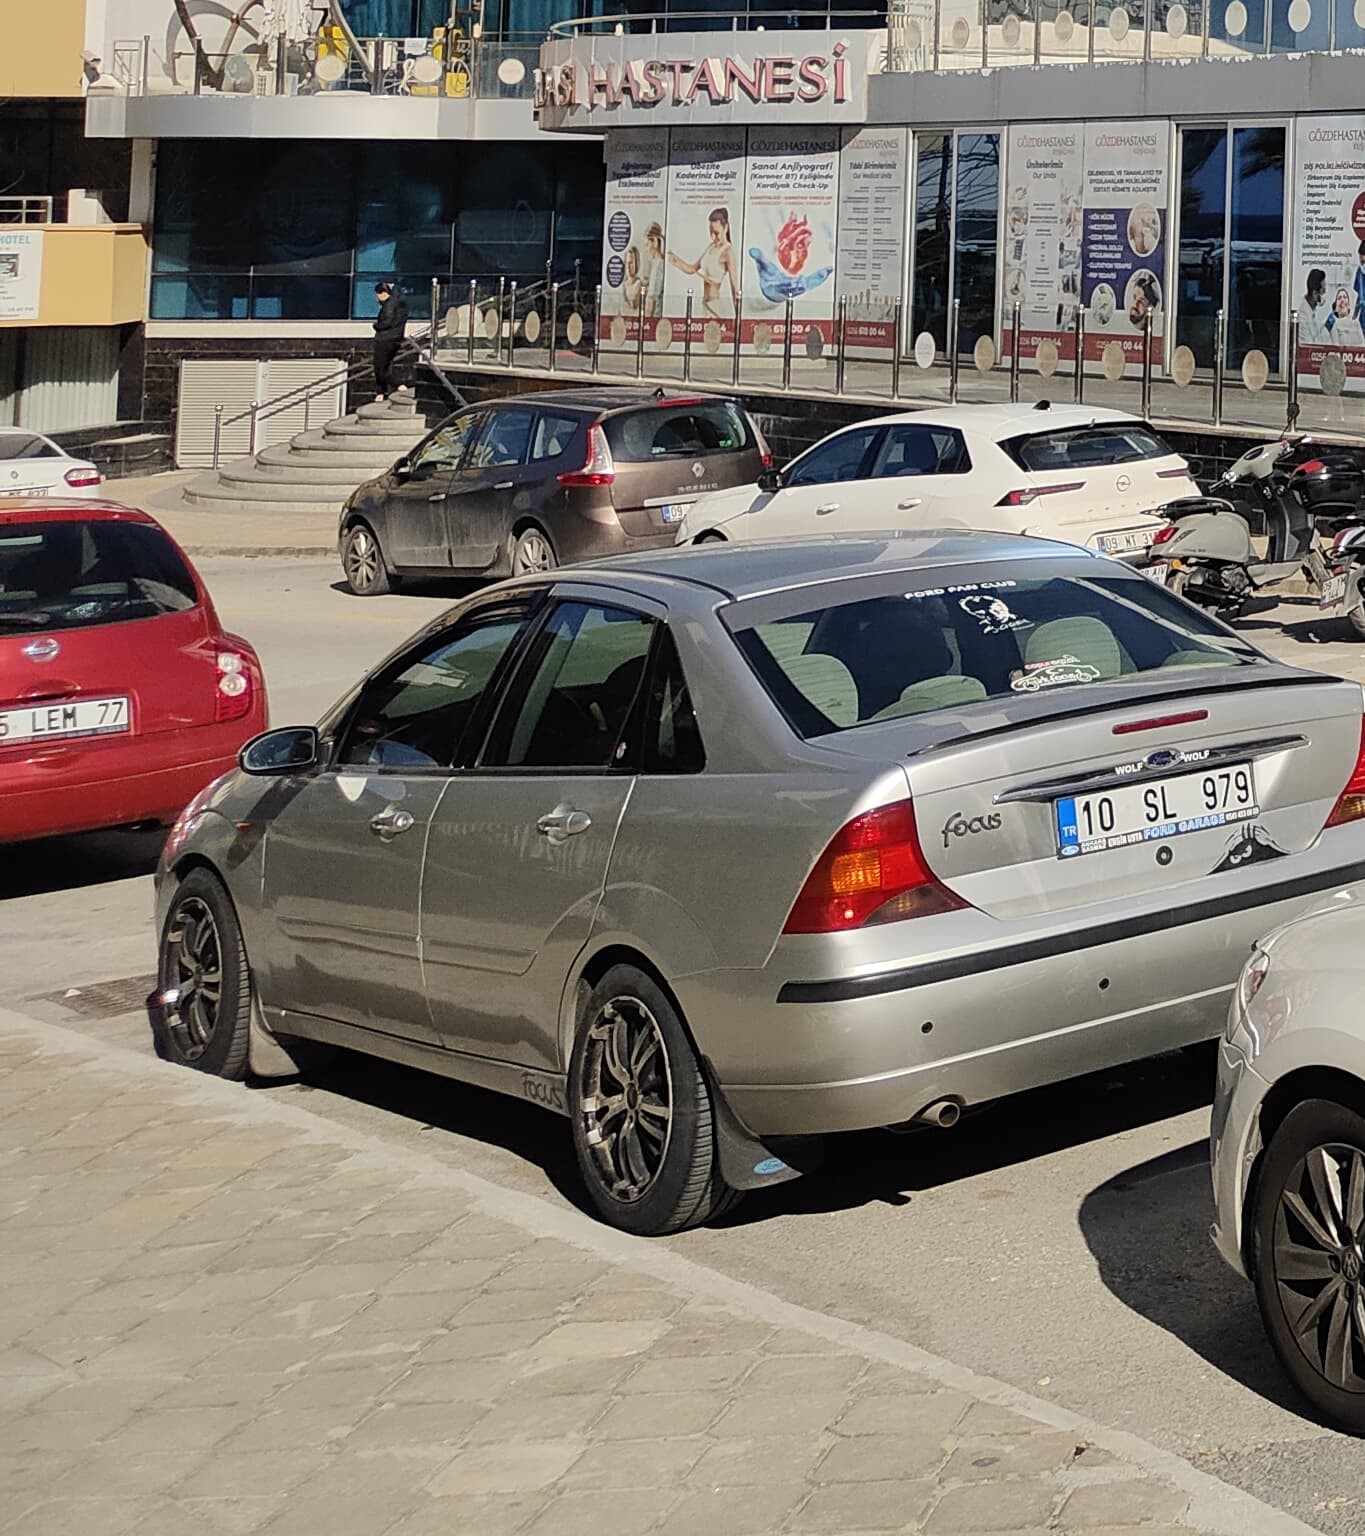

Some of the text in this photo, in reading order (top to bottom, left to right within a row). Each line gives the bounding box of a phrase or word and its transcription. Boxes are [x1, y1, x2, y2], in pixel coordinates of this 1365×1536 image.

[588, 40, 851, 109] HASTANESİ
[752, 162, 778, 171] Sanal
[670, 506, 683, 518] 09
[1105, 537, 1119, 551] 09
[903, 587, 945, 600] FORD
[947, 583, 979, 595] FAN
[32, 706, 78, 734] LEM
[98, 702, 124, 725] 77
[1182, 749, 1211, 763] WOLF
[1114, 762, 1144, 776] WOLF
[1062, 770, 1250, 838] TR 10 SL 979
[1143, 823, 1177, 841] FORD
[1178, 813, 1227, 833] GARAGE
